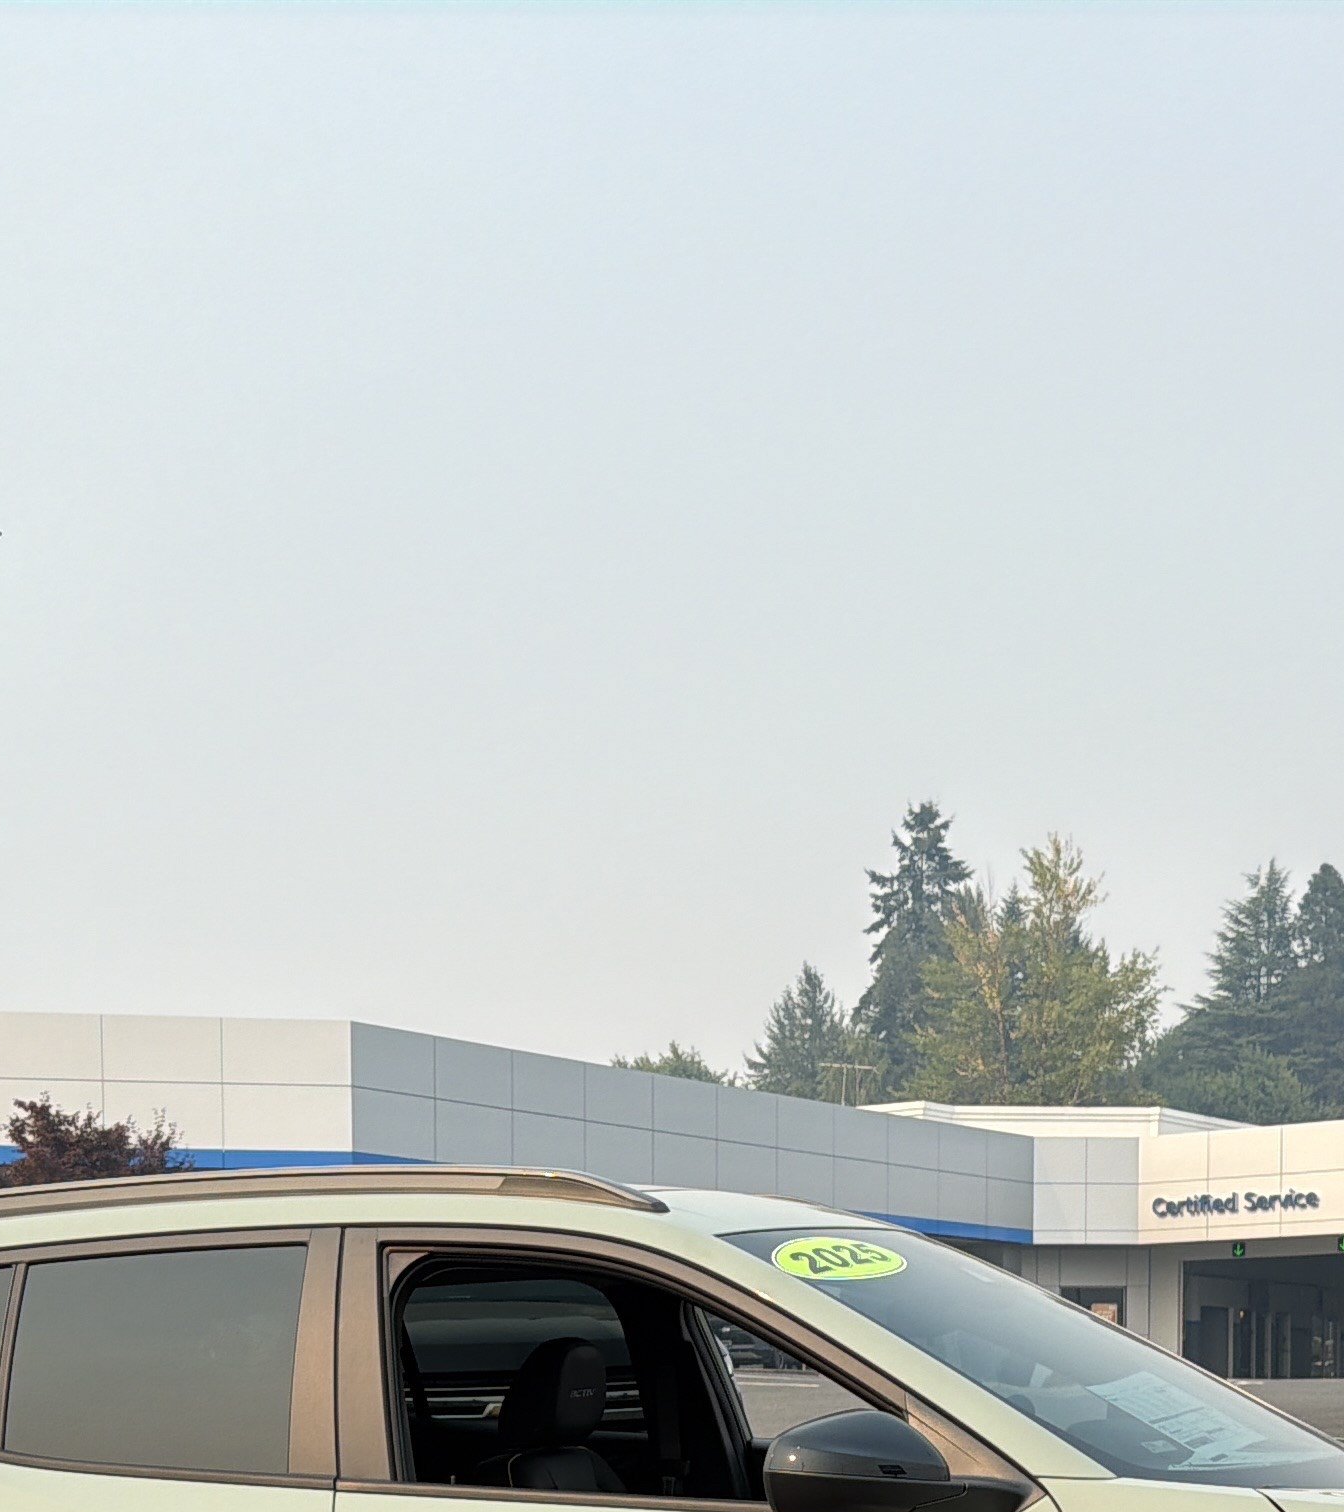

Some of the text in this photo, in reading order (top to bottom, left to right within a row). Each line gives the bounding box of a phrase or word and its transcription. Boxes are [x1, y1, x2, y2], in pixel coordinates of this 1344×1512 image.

[1152, 1188, 1320, 1218] Certified Service
[789, 1243, 893, 1275] 2025
